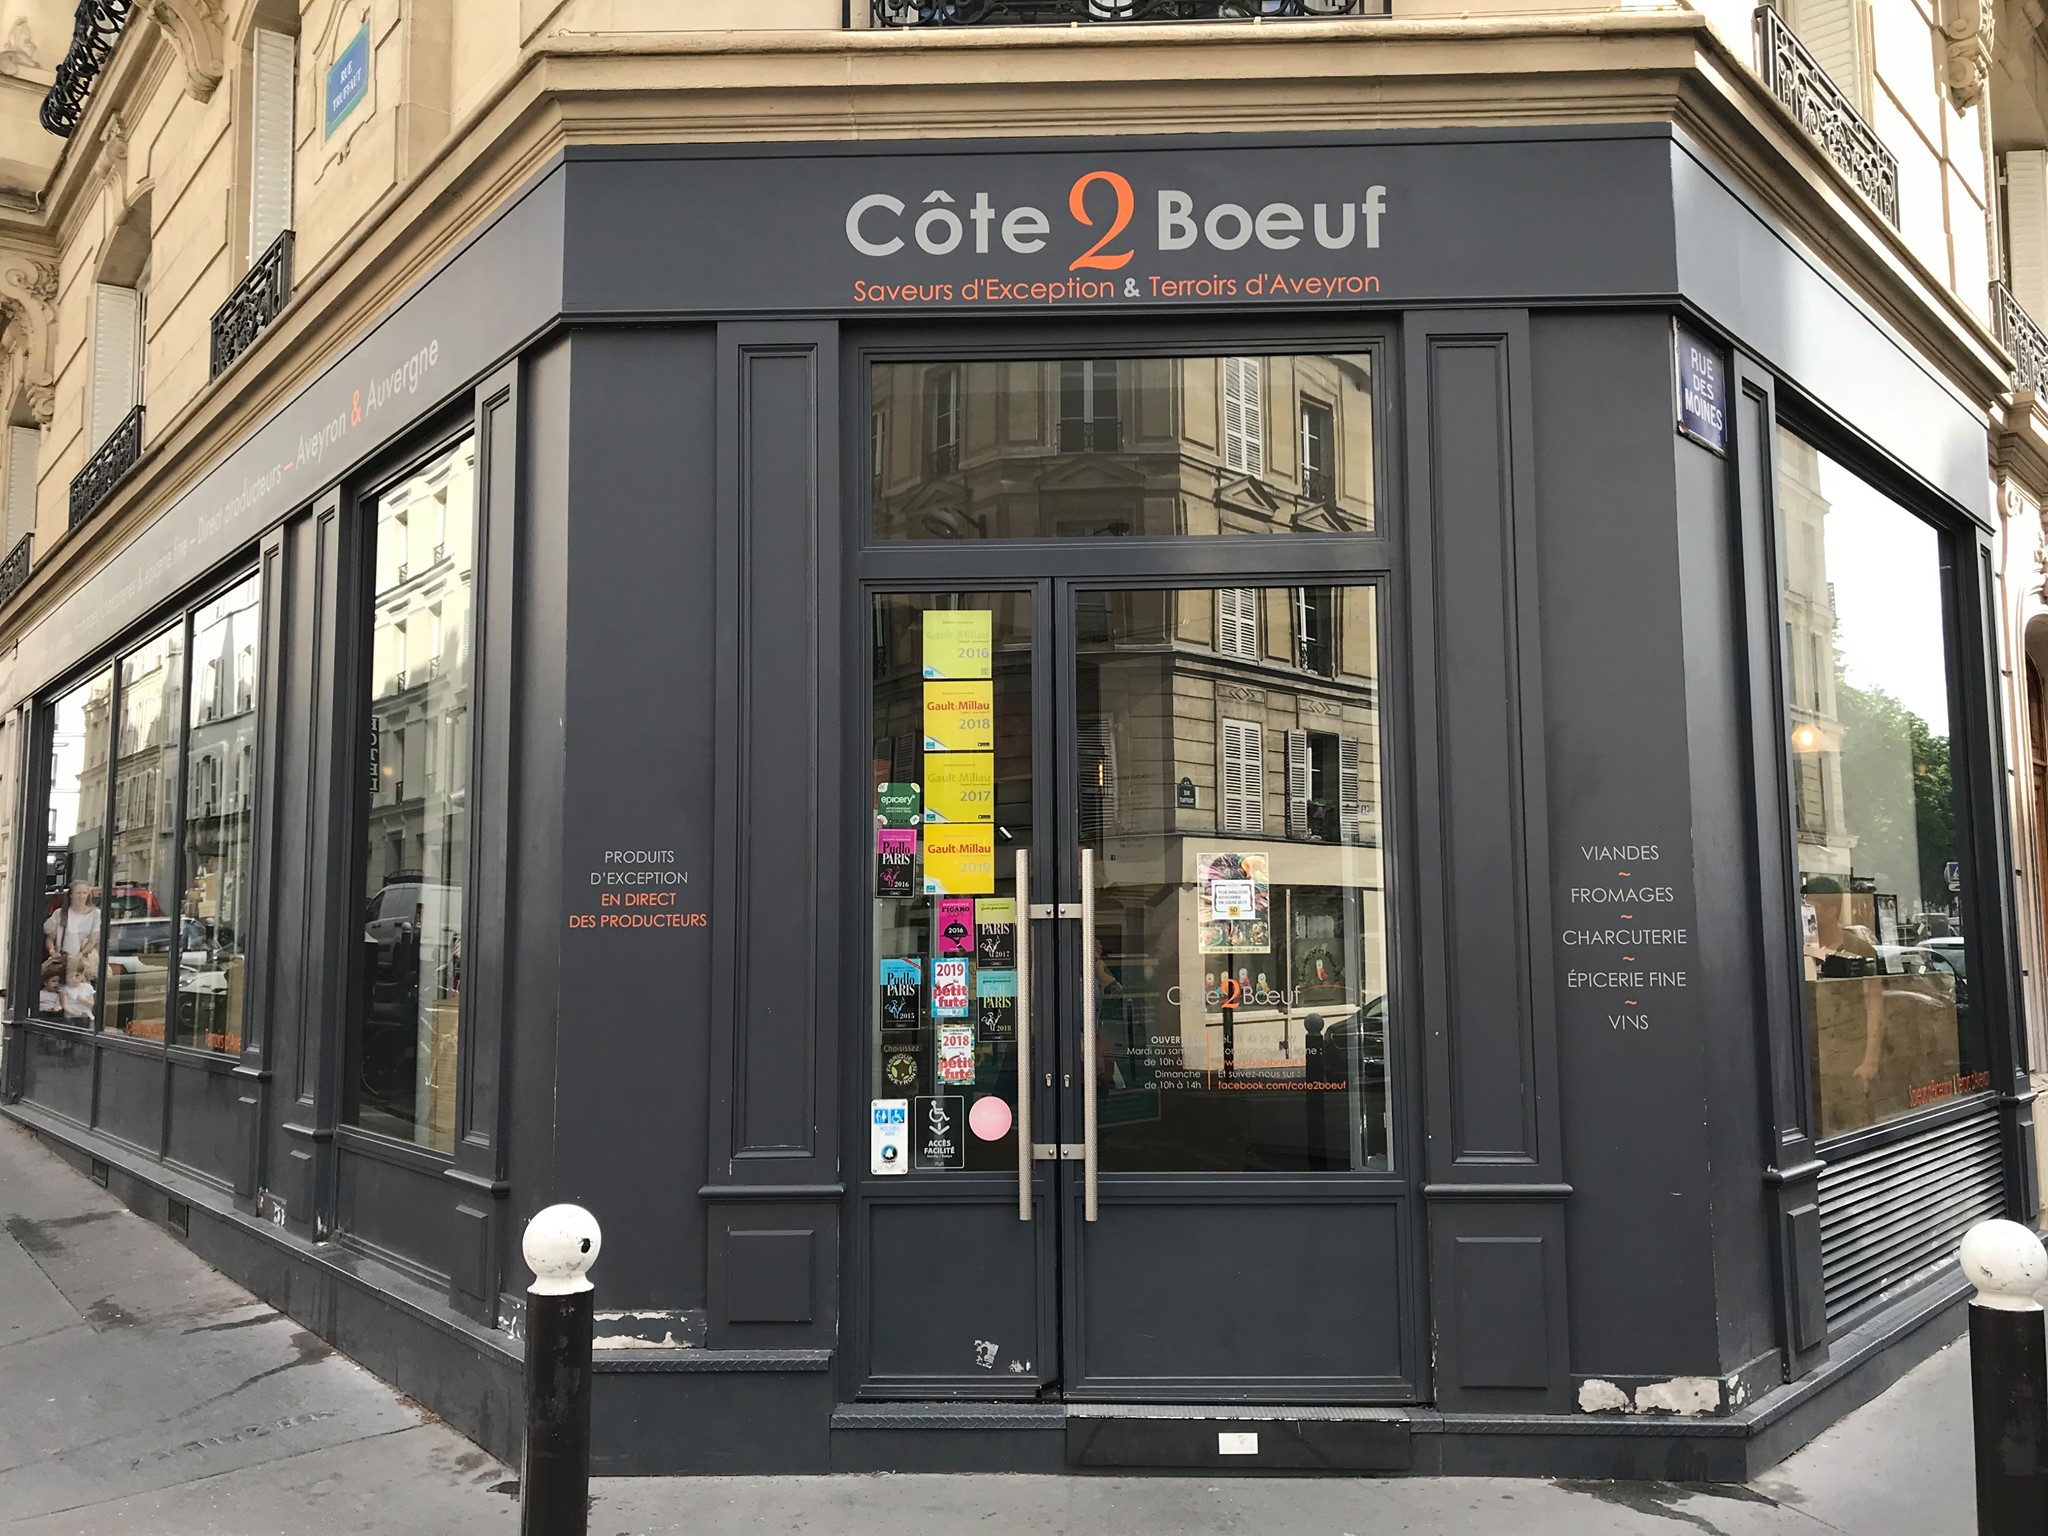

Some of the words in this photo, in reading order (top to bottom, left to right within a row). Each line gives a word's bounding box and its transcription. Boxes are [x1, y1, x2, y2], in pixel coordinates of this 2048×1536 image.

[340, 60, 353, 84] RUE
[332, 67, 362, 111] TRUFFAUT
[845, 190, 1050, 256] Côte
[1069, 170, 1134, 271] 2
[1158, 185, 1386, 251] Boeuf
[853, 278, 953, 302] Saveurs
[961, 276, 1115, 303] d'Exception
[1123, 277, 1141, 297] &
[1148, 274, 1238, 297] Terroirs
[1245, 272, 1380, 298] d'Aveyron
[1690, 346, 1714, 381] RUE
[1692, 373, 1715, 401] DES
[1684, 387, 1723, 431] MOINES
[223, 463, 281, 534] producteurs
[295, 411, 347, 470] Aveyron
[351, 389, 362, 427] &
[365, 338, 439, 417] Auvergne
[958, 648, 990, 658] 2016
[959, 719, 990, 730] 2018
[959, 791, 991, 801] 2017
[604, 850, 675, 864] PRODUITS
[882, 853, 911, 865] PARIS
[1581, 845, 1659, 861] VIANDES
[959, 863, 991, 873] 2019
[590, 871, 688, 885] D'EXCEPTION
[601, 893, 620, 906] EN
[625, 892, 676, 906] DIRECT
[1571, 886, 1674, 903] FROMAGES
[569, 915, 596, 928] DES
[600, 913, 707, 928] PRODUCTEURS
[982, 923, 1010, 935] PARIS
[1562, 929, 1687, 945] CHARCUTERIE
[936, 963, 965, 977] 2019
[887, 972, 915, 985] Pudlo
[1567, 969, 1644, 988] ÉPICERIE
[1649, 971, 1687, 987] FINE
[887, 984, 915, 996] PARIS
[1221, 979, 1240, 1008] 2
[983, 997, 1012, 1008] PARIS
[1608, 1014, 1649, 1030] VINS
[943, 1035, 970, 1046] 2018
[883, 1044, 921, 1053] Choisissez
[1127, 1047, 1153, 1055] Mardi
[1144, 1058, 1156, 1066] de
[1159, 1058, 1174, 1066] 10h
[1176, 1058, 1183, 1066] à
[887, 1073, 917, 1086] AVEYRON
[1155, 1070, 1201, 1078] Dimanche
[1218, 1070, 1226, 1078] Et
[1228, 1070, 1280, 1079] suivez-nous
[1282, 1071, 1296, 1079] sur
[1144, 1081, 1157, 1089] de
[1159, 1081, 1175, 1089] 10h
[1176, 1081, 1183, 1089] à
[1186, 1081, 1202, 1089] 14h
[1218, 1080, 1347, 1091] facebook.com/cote2boeuf
[928, 1138, 952, 1147] ACCÈS
[923, 1145, 956, 1155] FACILITÉ
